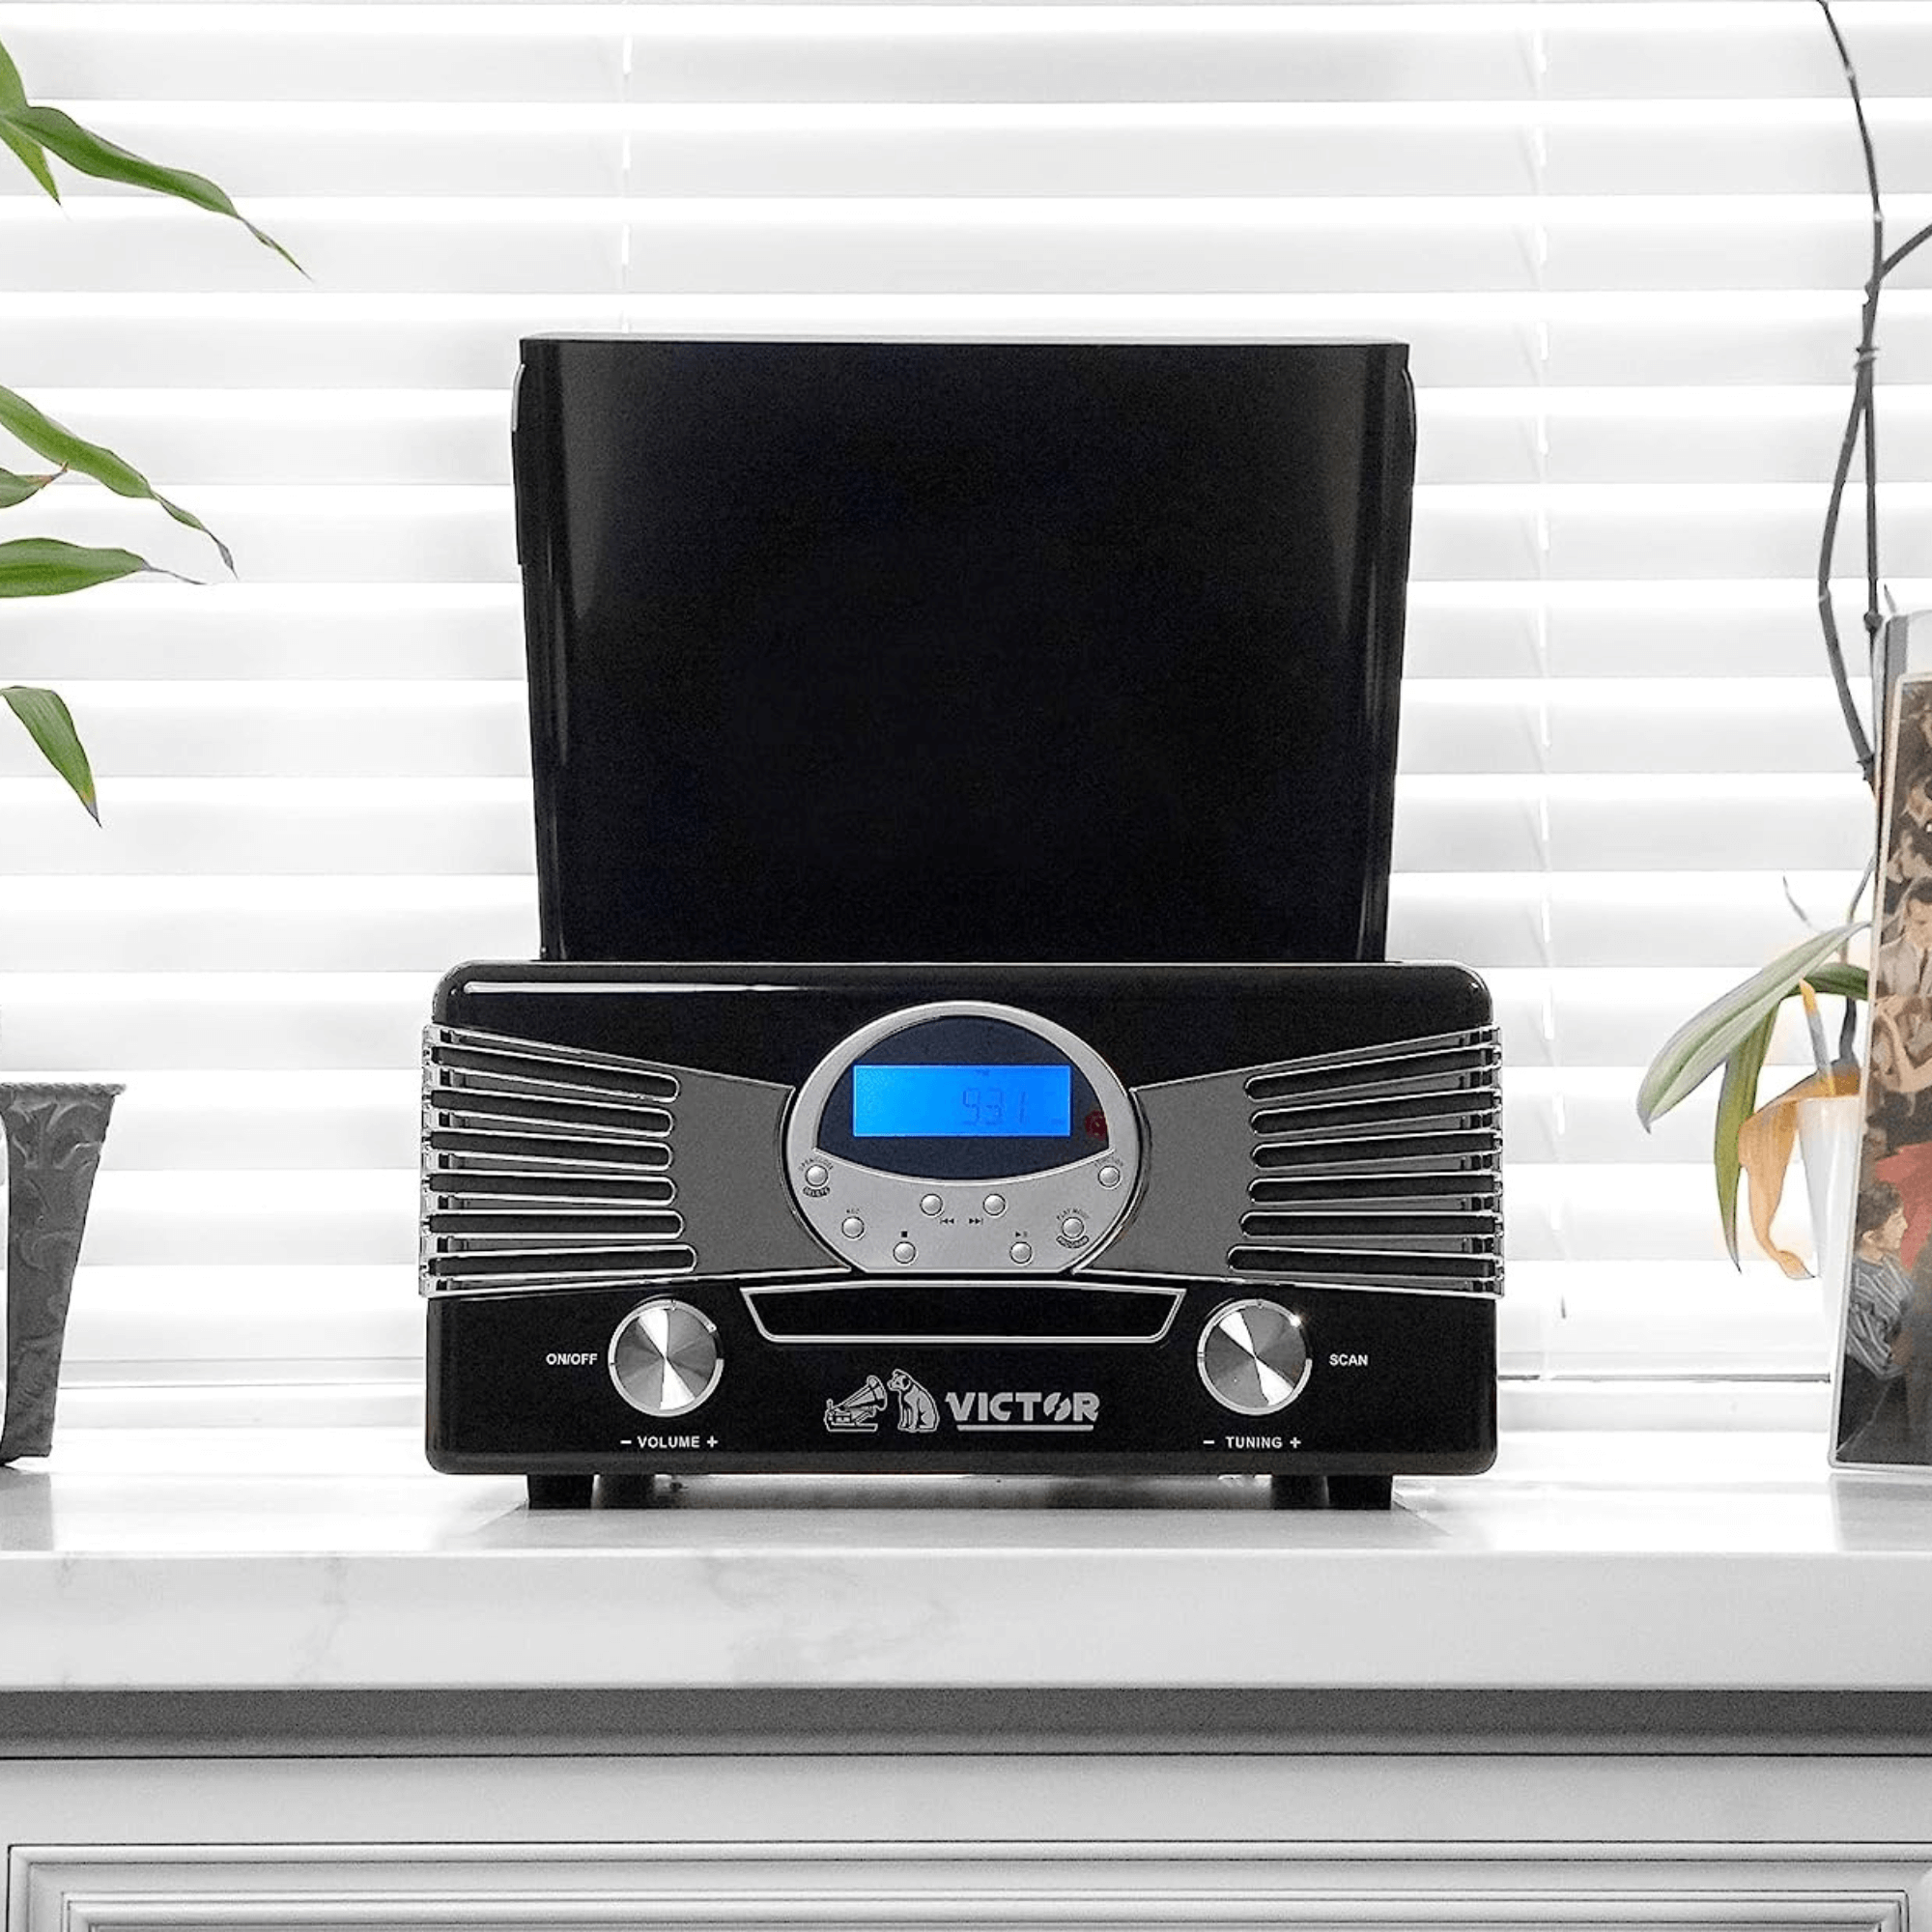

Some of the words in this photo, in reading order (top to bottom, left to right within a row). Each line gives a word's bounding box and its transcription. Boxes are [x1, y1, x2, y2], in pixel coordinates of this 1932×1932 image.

[545, 1352, 598, 1366] ON/OFF
[1328, 1353, 1369, 1367] SCAN
[945, 1391, 1101, 1423] VICTOR
[637, 1435, 701, 1449] VOLUME
[1225, 1435, 1284, 1449] TUNING
